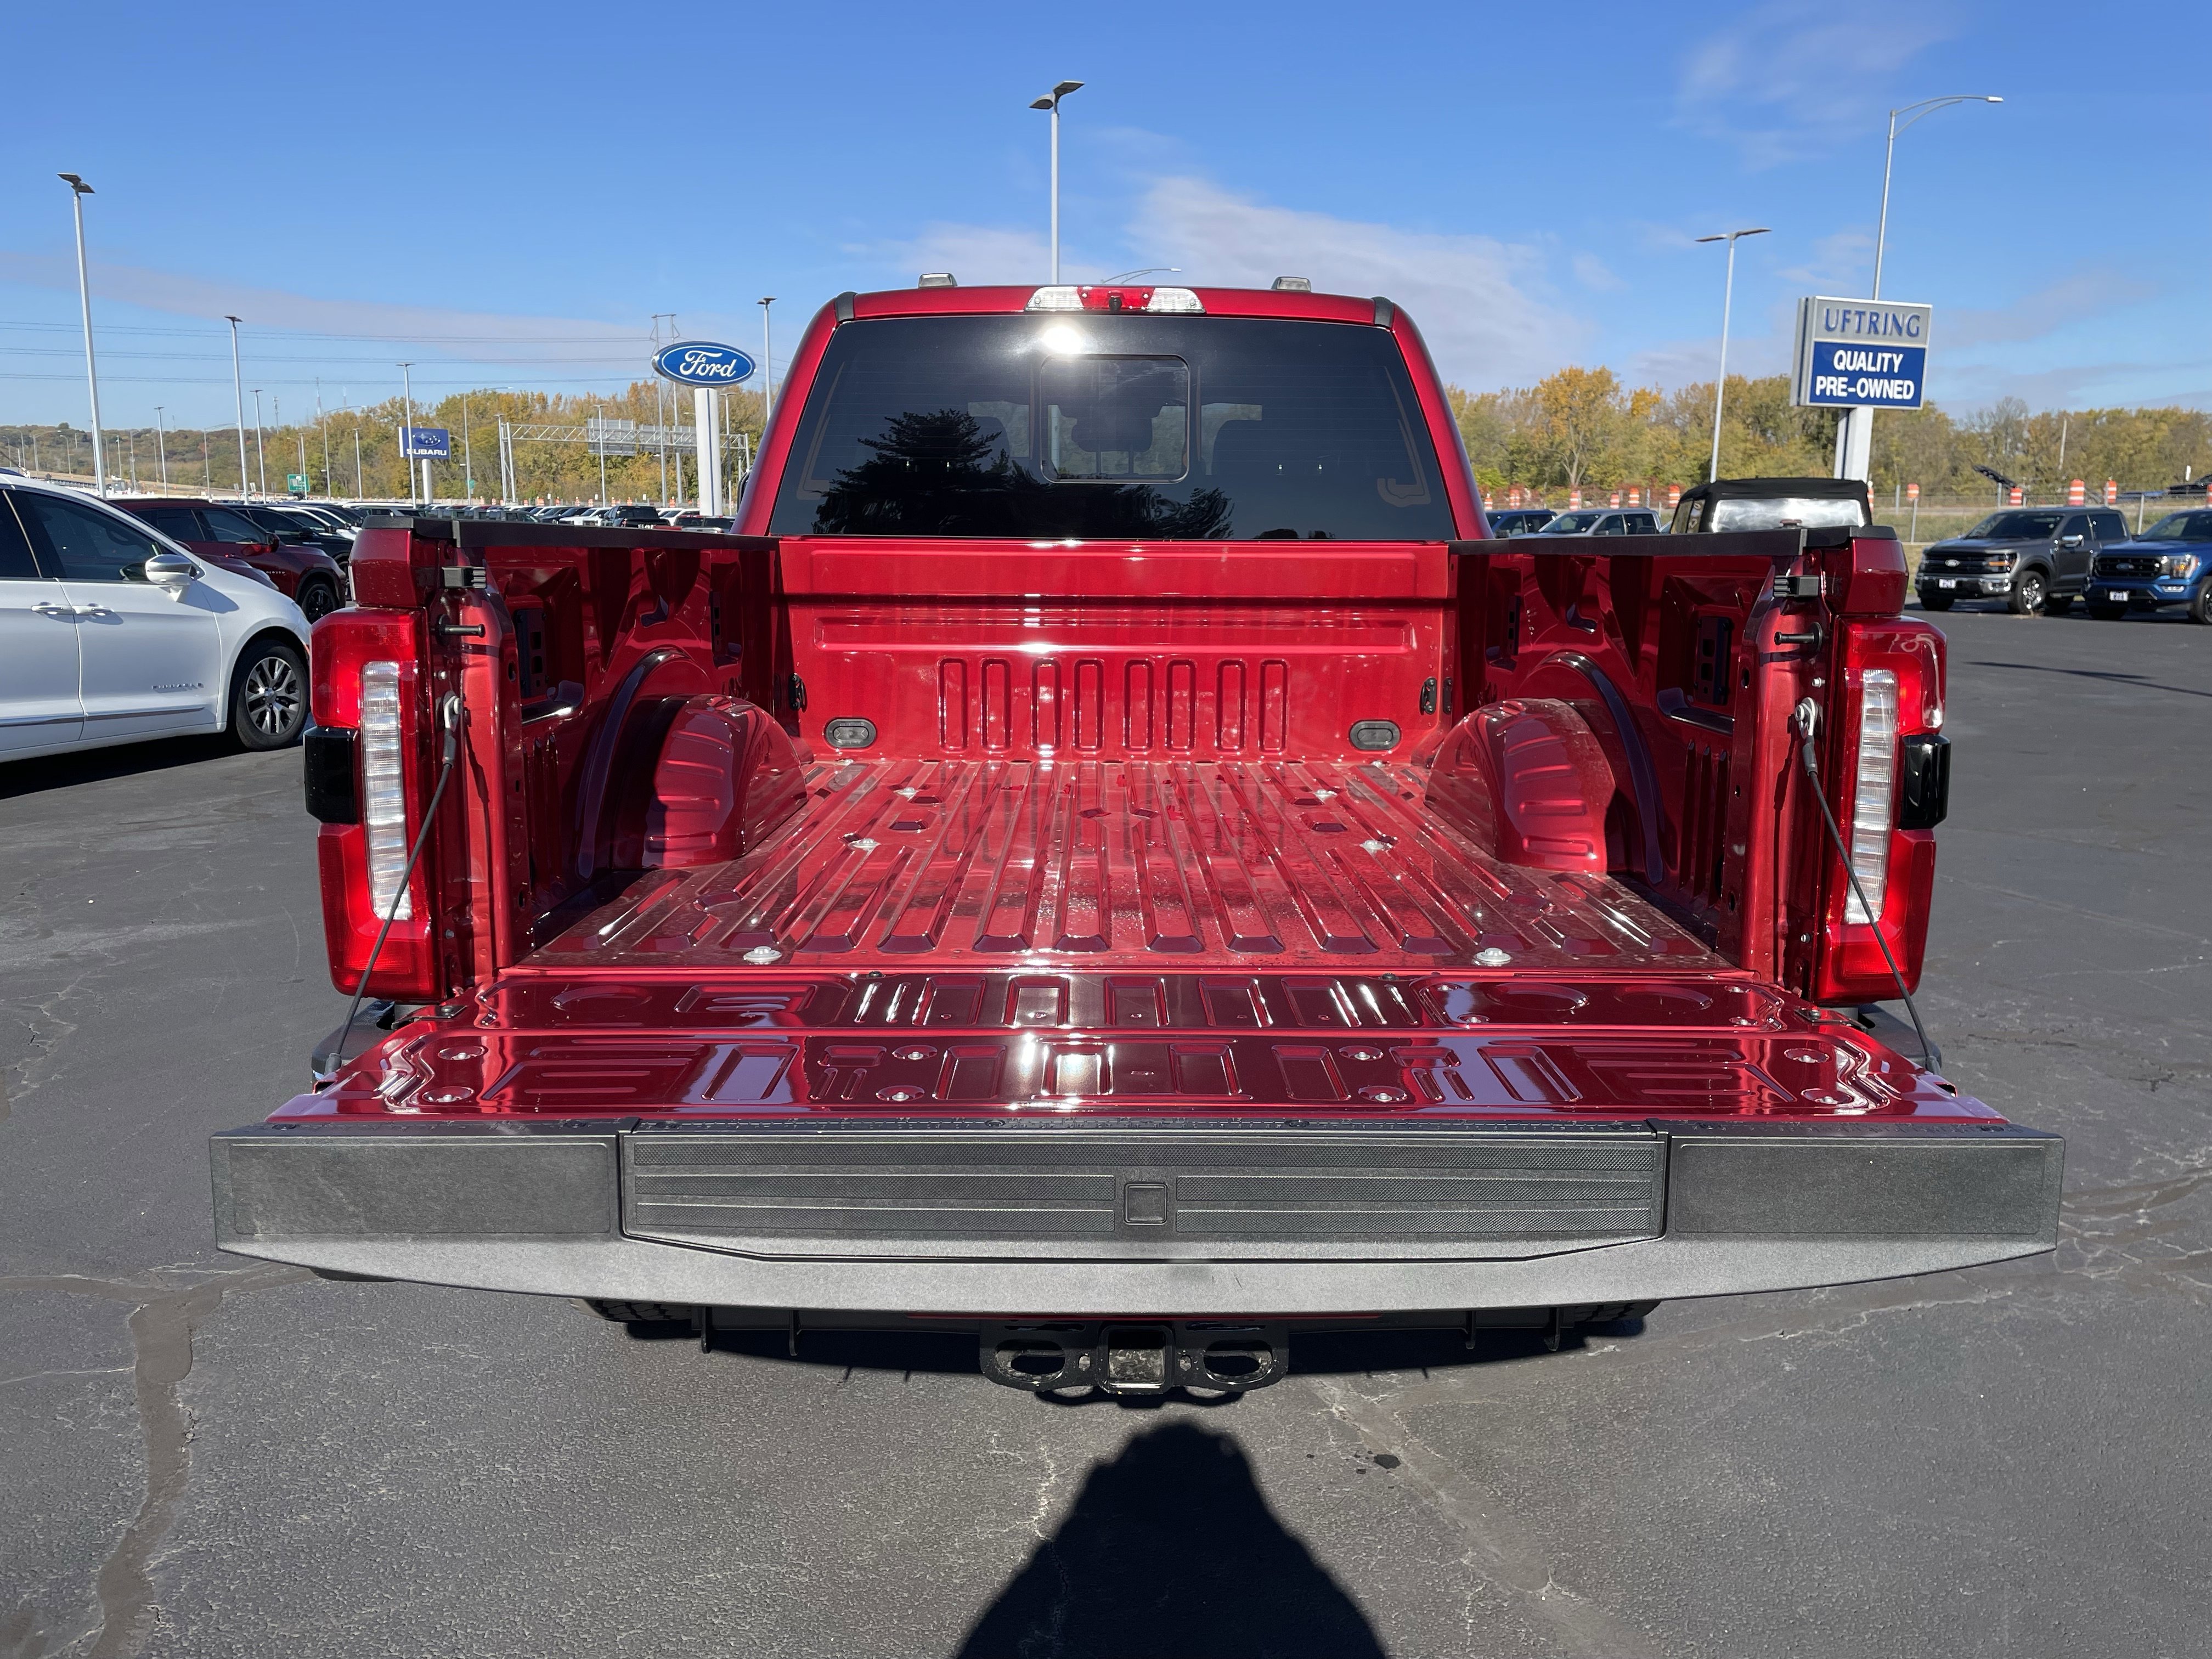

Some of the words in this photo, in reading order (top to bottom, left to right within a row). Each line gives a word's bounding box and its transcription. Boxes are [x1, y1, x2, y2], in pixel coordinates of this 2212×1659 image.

[1824, 308, 1920, 337] UFTRING
[679, 350, 737, 377] Ford
[1833, 349, 1904, 373] QUALITY
[1815, 376, 1915, 399] PRE-OWNED
